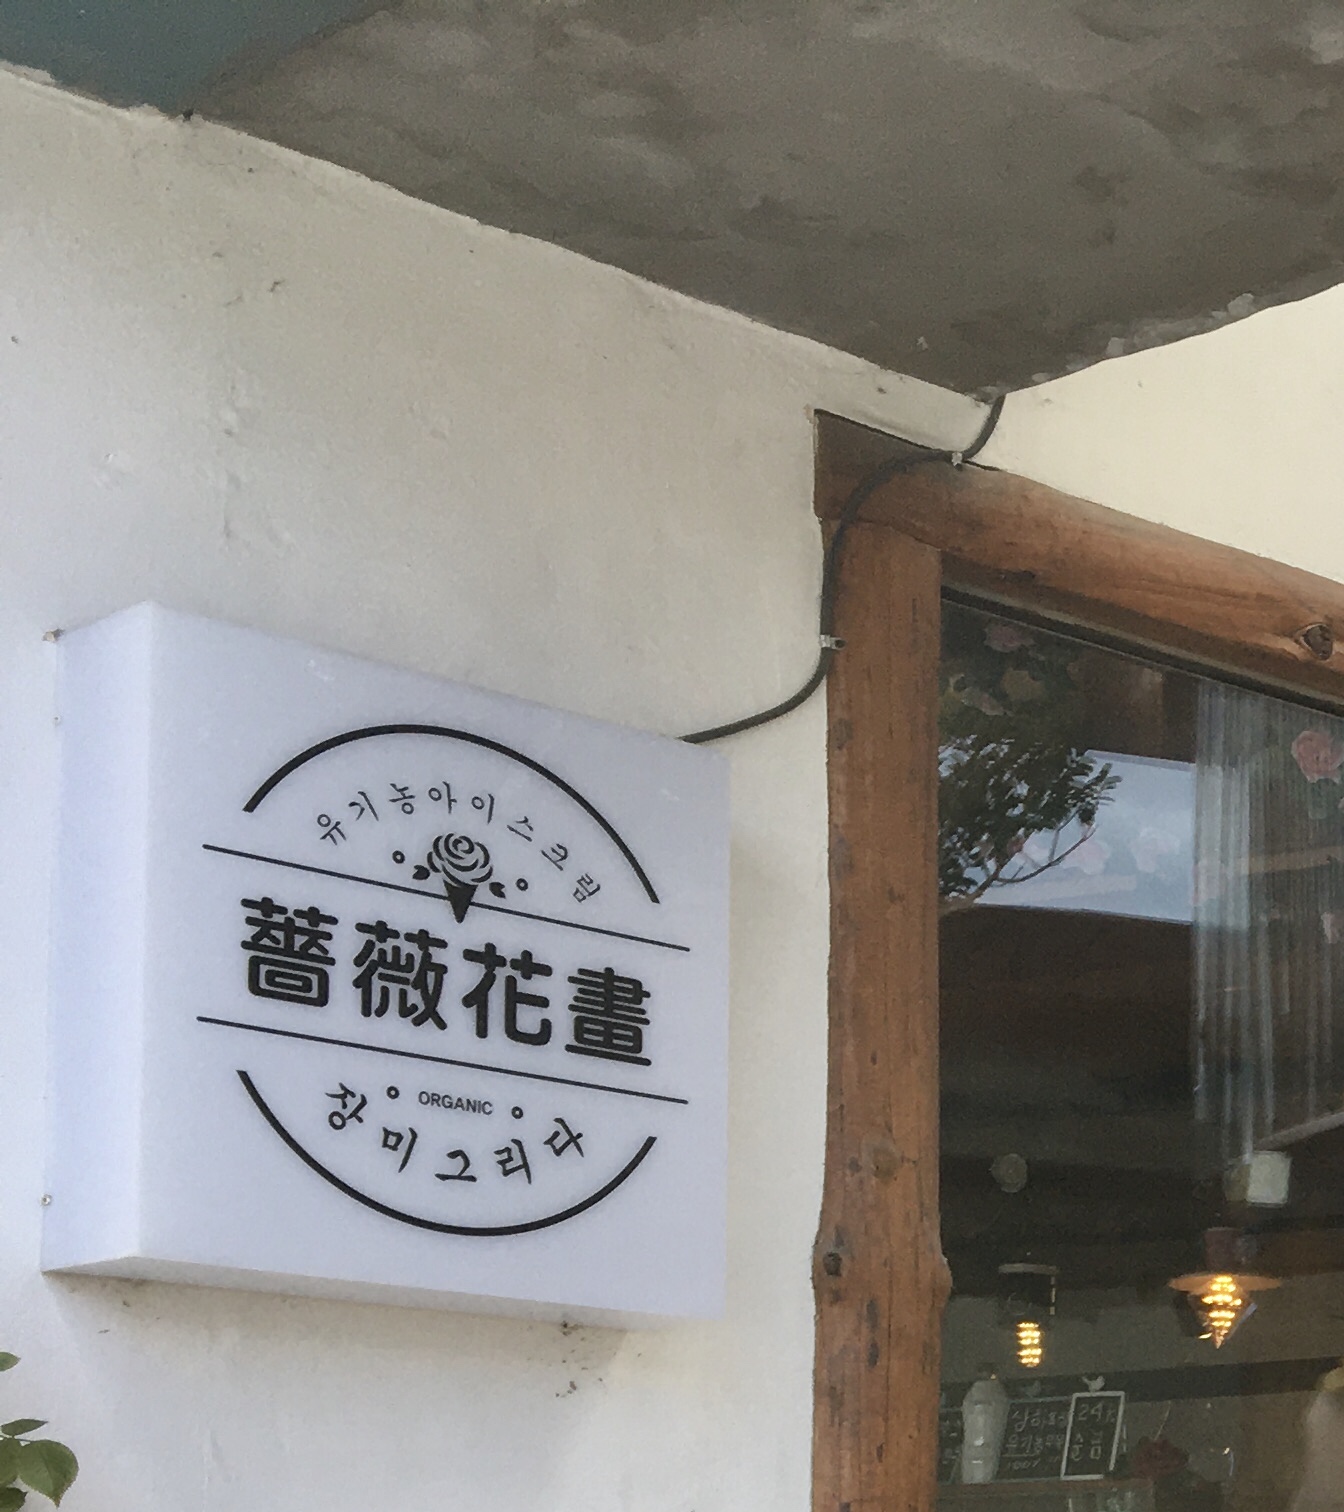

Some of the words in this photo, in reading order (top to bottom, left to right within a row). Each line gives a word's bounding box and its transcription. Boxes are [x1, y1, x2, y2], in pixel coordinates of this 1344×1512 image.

[316, 781, 602, 903] 유기농아이스크림
[240, 895, 653, 1067] 薔薇花畫
[323, 1081, 588, 1185] 장미그리다
[417, 1089, 494, 1117] ORGANIC
